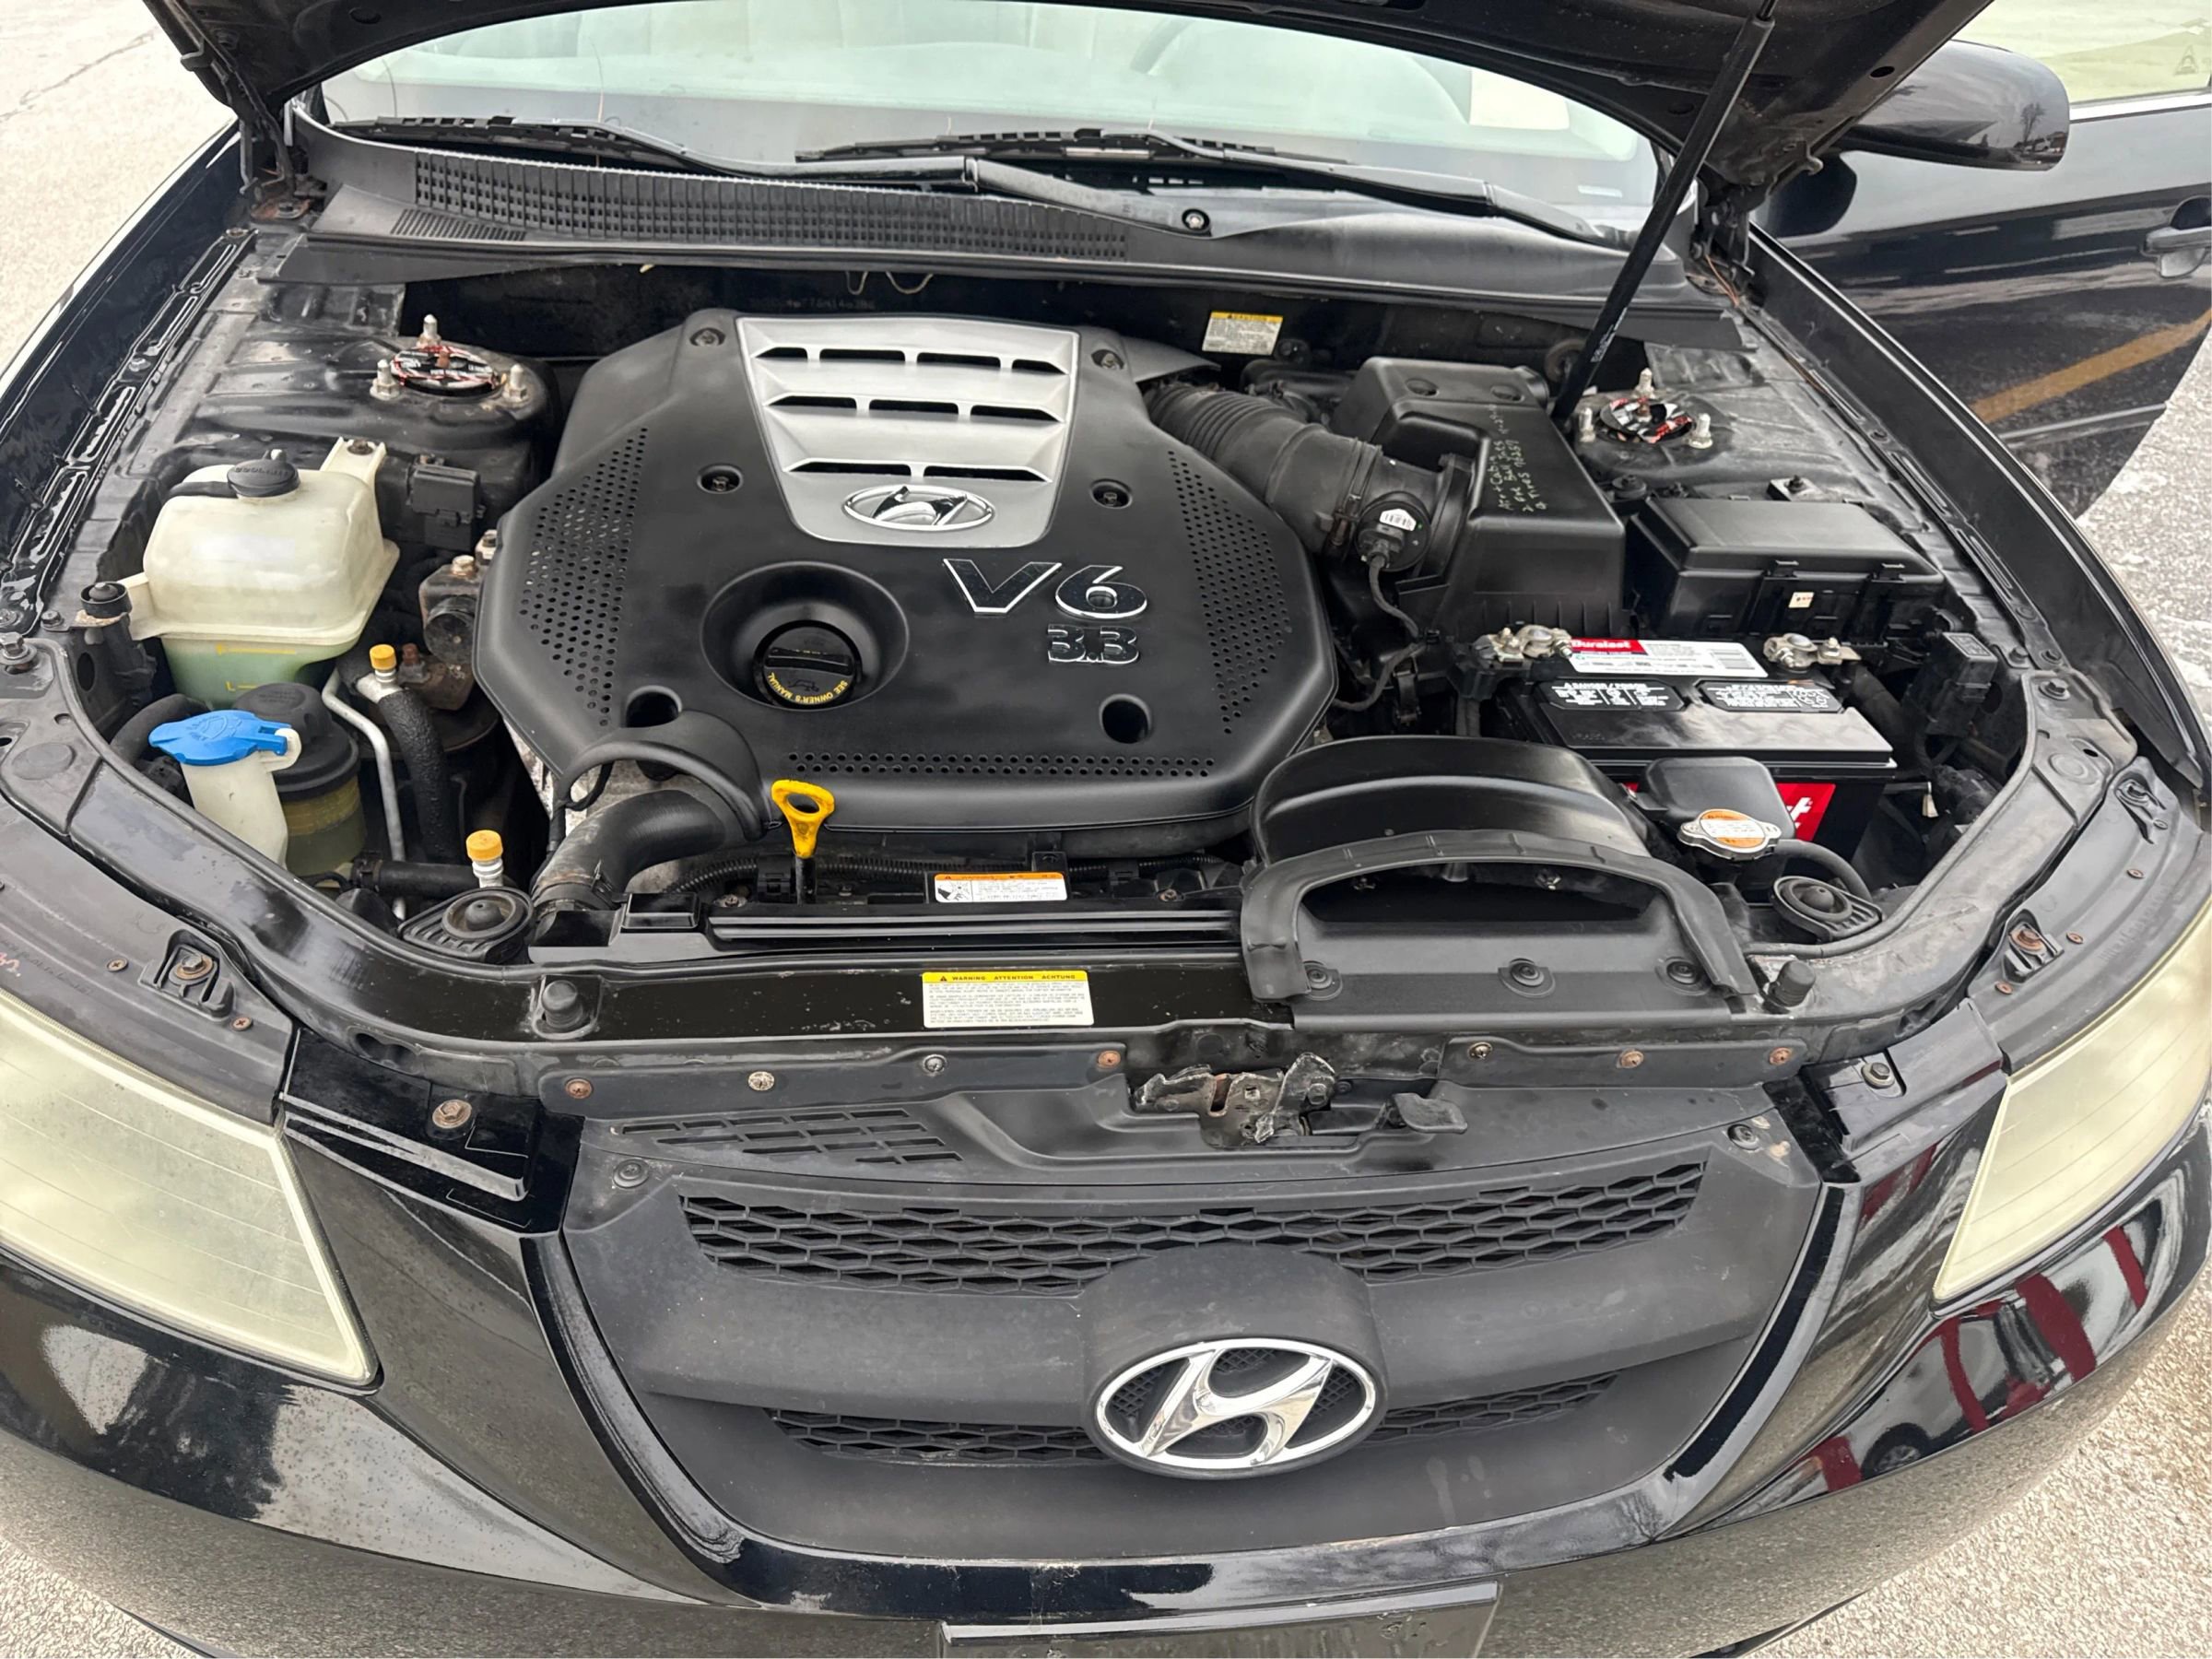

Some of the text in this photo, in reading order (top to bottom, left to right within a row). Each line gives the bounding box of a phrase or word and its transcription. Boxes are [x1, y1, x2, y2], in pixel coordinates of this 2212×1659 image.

[942, 558, 1148, 619] V6
[1571, 639, 1631, 649] Duralast
[767, 672, 849, 705] SEE OWNER'S MANUAL
